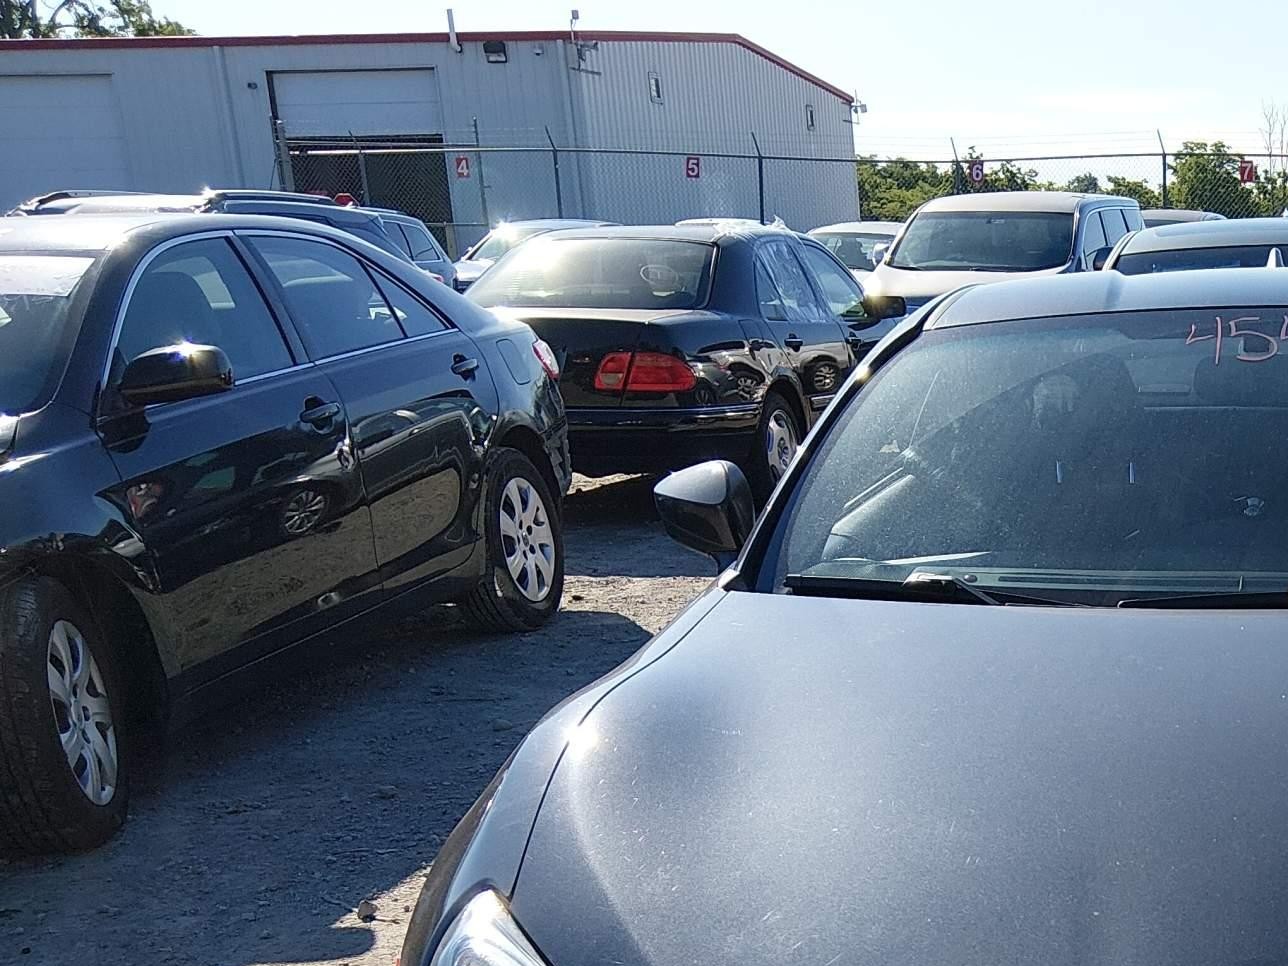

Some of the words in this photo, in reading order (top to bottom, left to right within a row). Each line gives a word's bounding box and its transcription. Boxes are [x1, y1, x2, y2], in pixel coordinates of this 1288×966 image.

[457, 159, 469, 176] 4
[687, 159, 699, 176] 5
[972, 164, 983, 181] 6
[1241, 162, 1252, 181] 7
